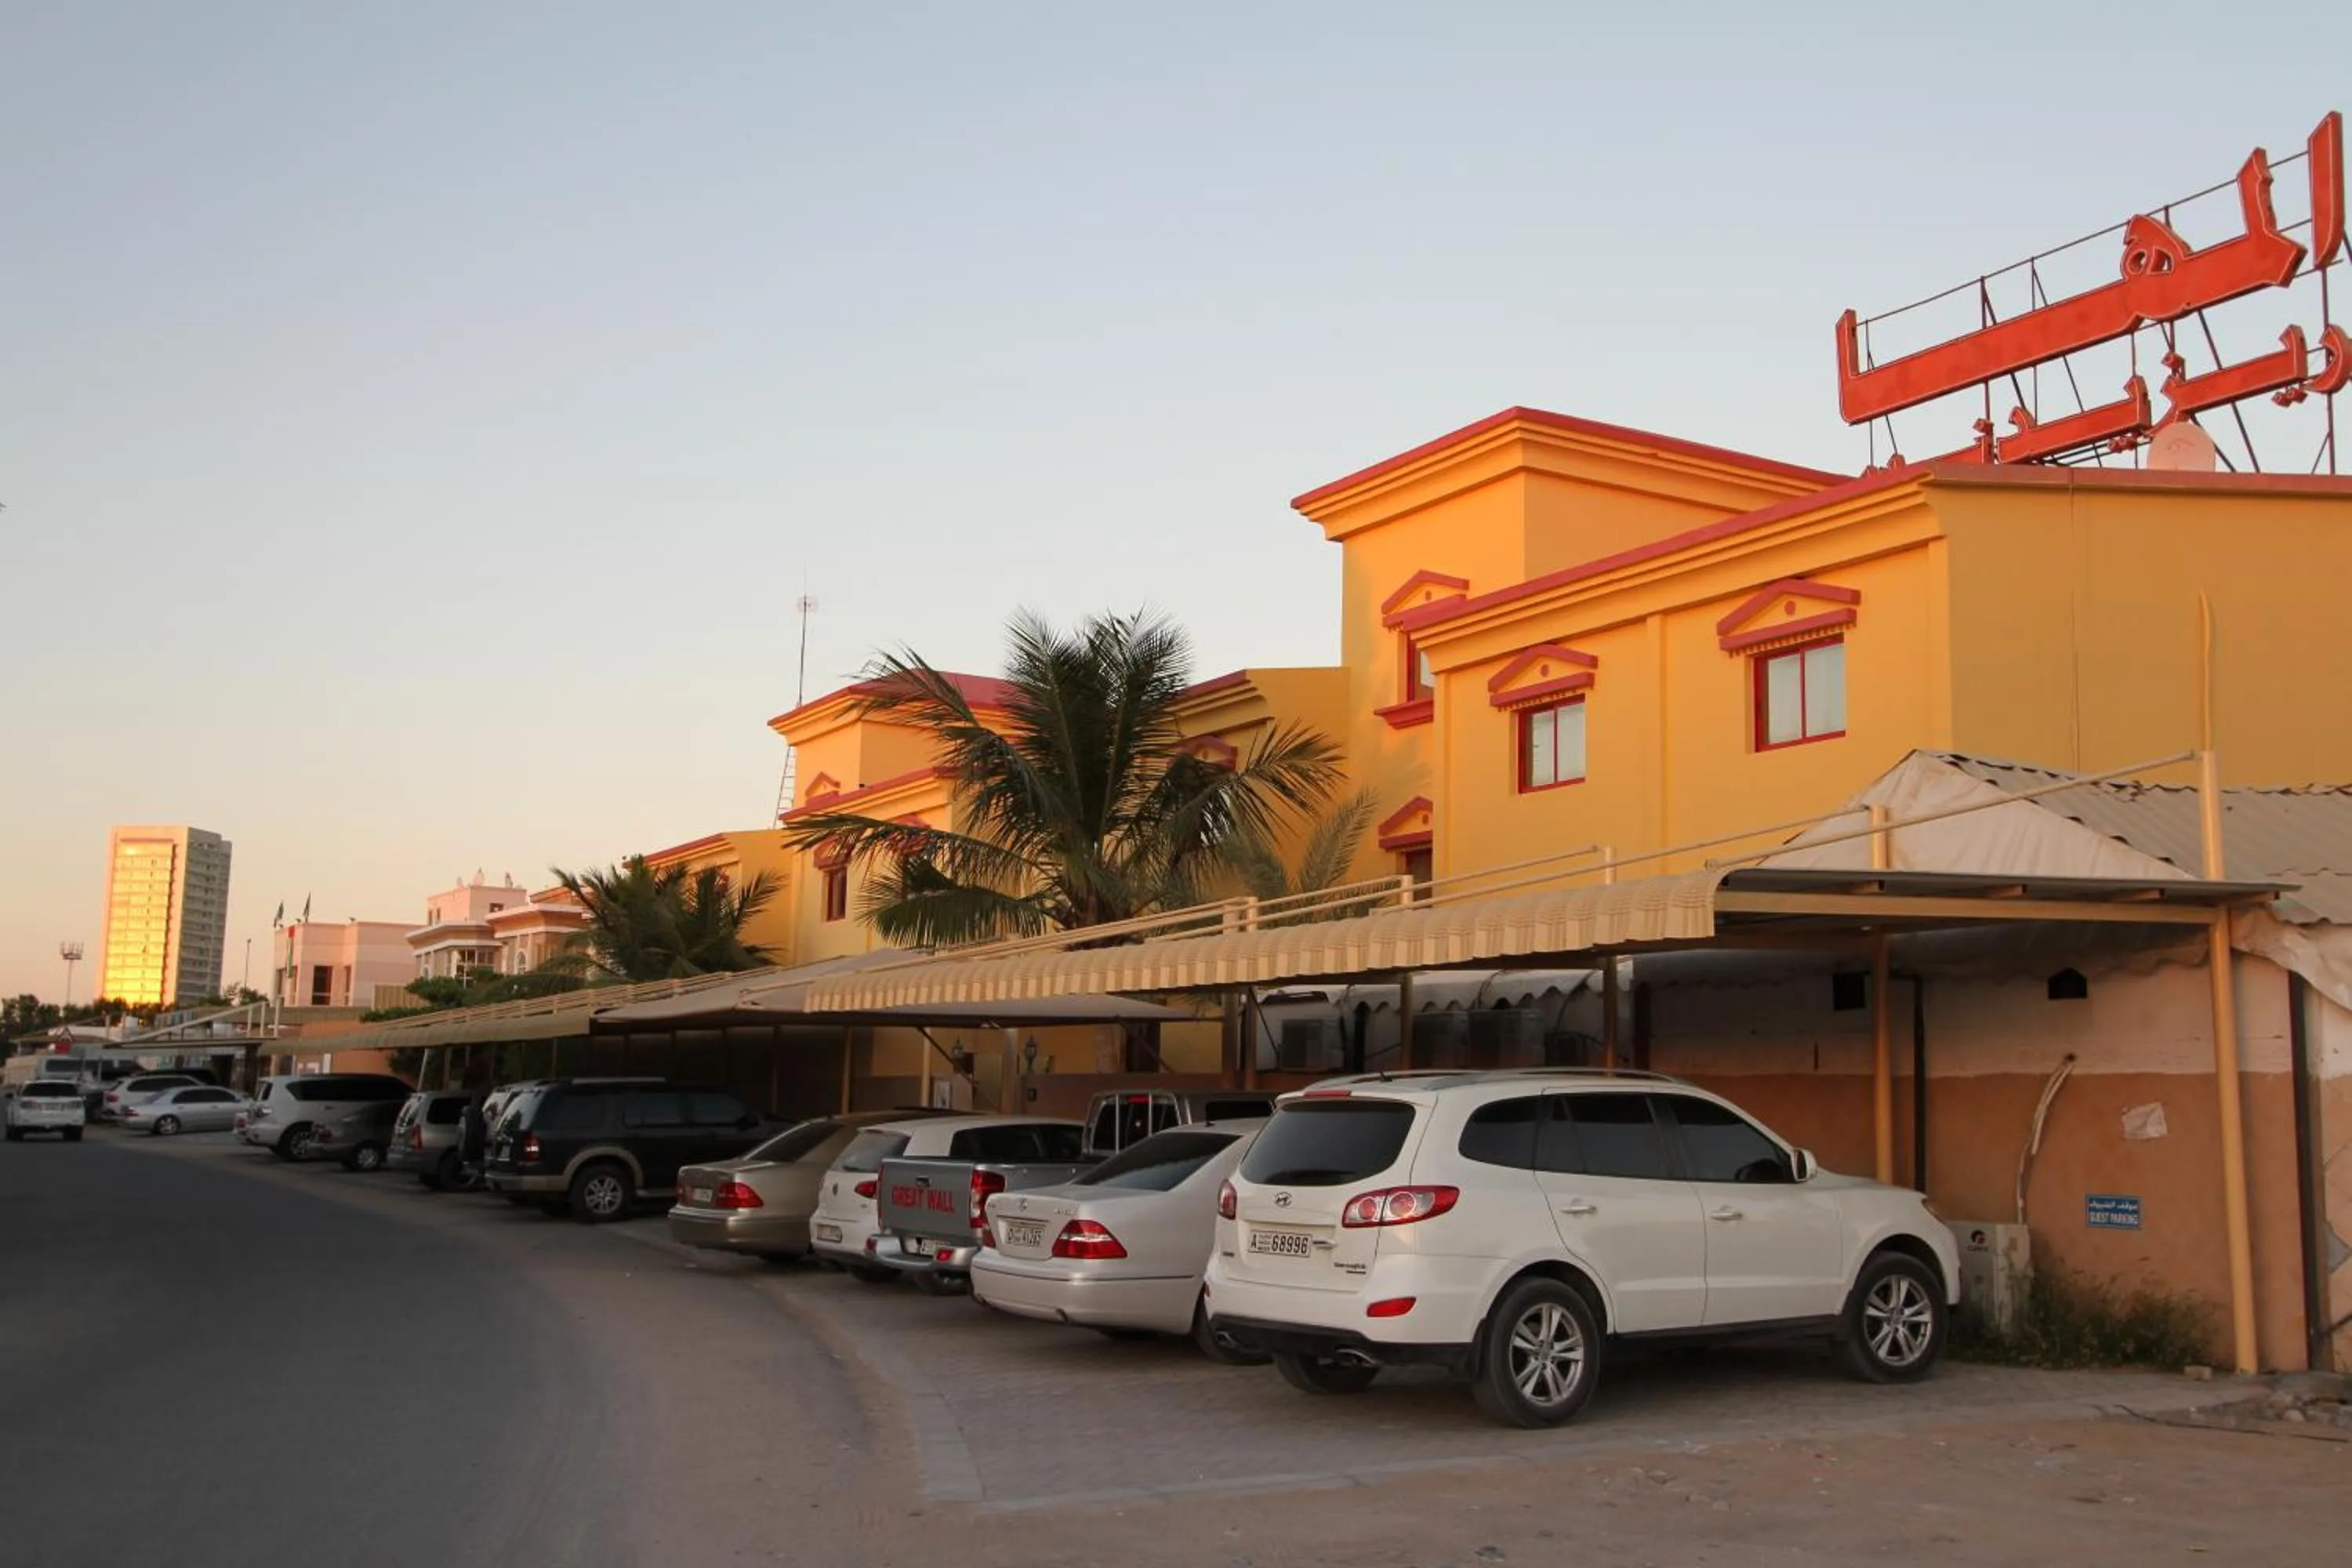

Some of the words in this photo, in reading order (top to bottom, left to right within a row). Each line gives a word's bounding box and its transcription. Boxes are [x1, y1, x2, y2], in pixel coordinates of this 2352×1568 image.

[891, 1184, 923, 1208] GREAT
[927, 1189, 955, 1214] WALL
[2089, 1210, 2109, 1223] GUEST
[2110, 1212, 2139, 1225] PARKING
[1250, 1233, 1257, 1249] A
[1271, 1235, 1308, 1254] 68996
